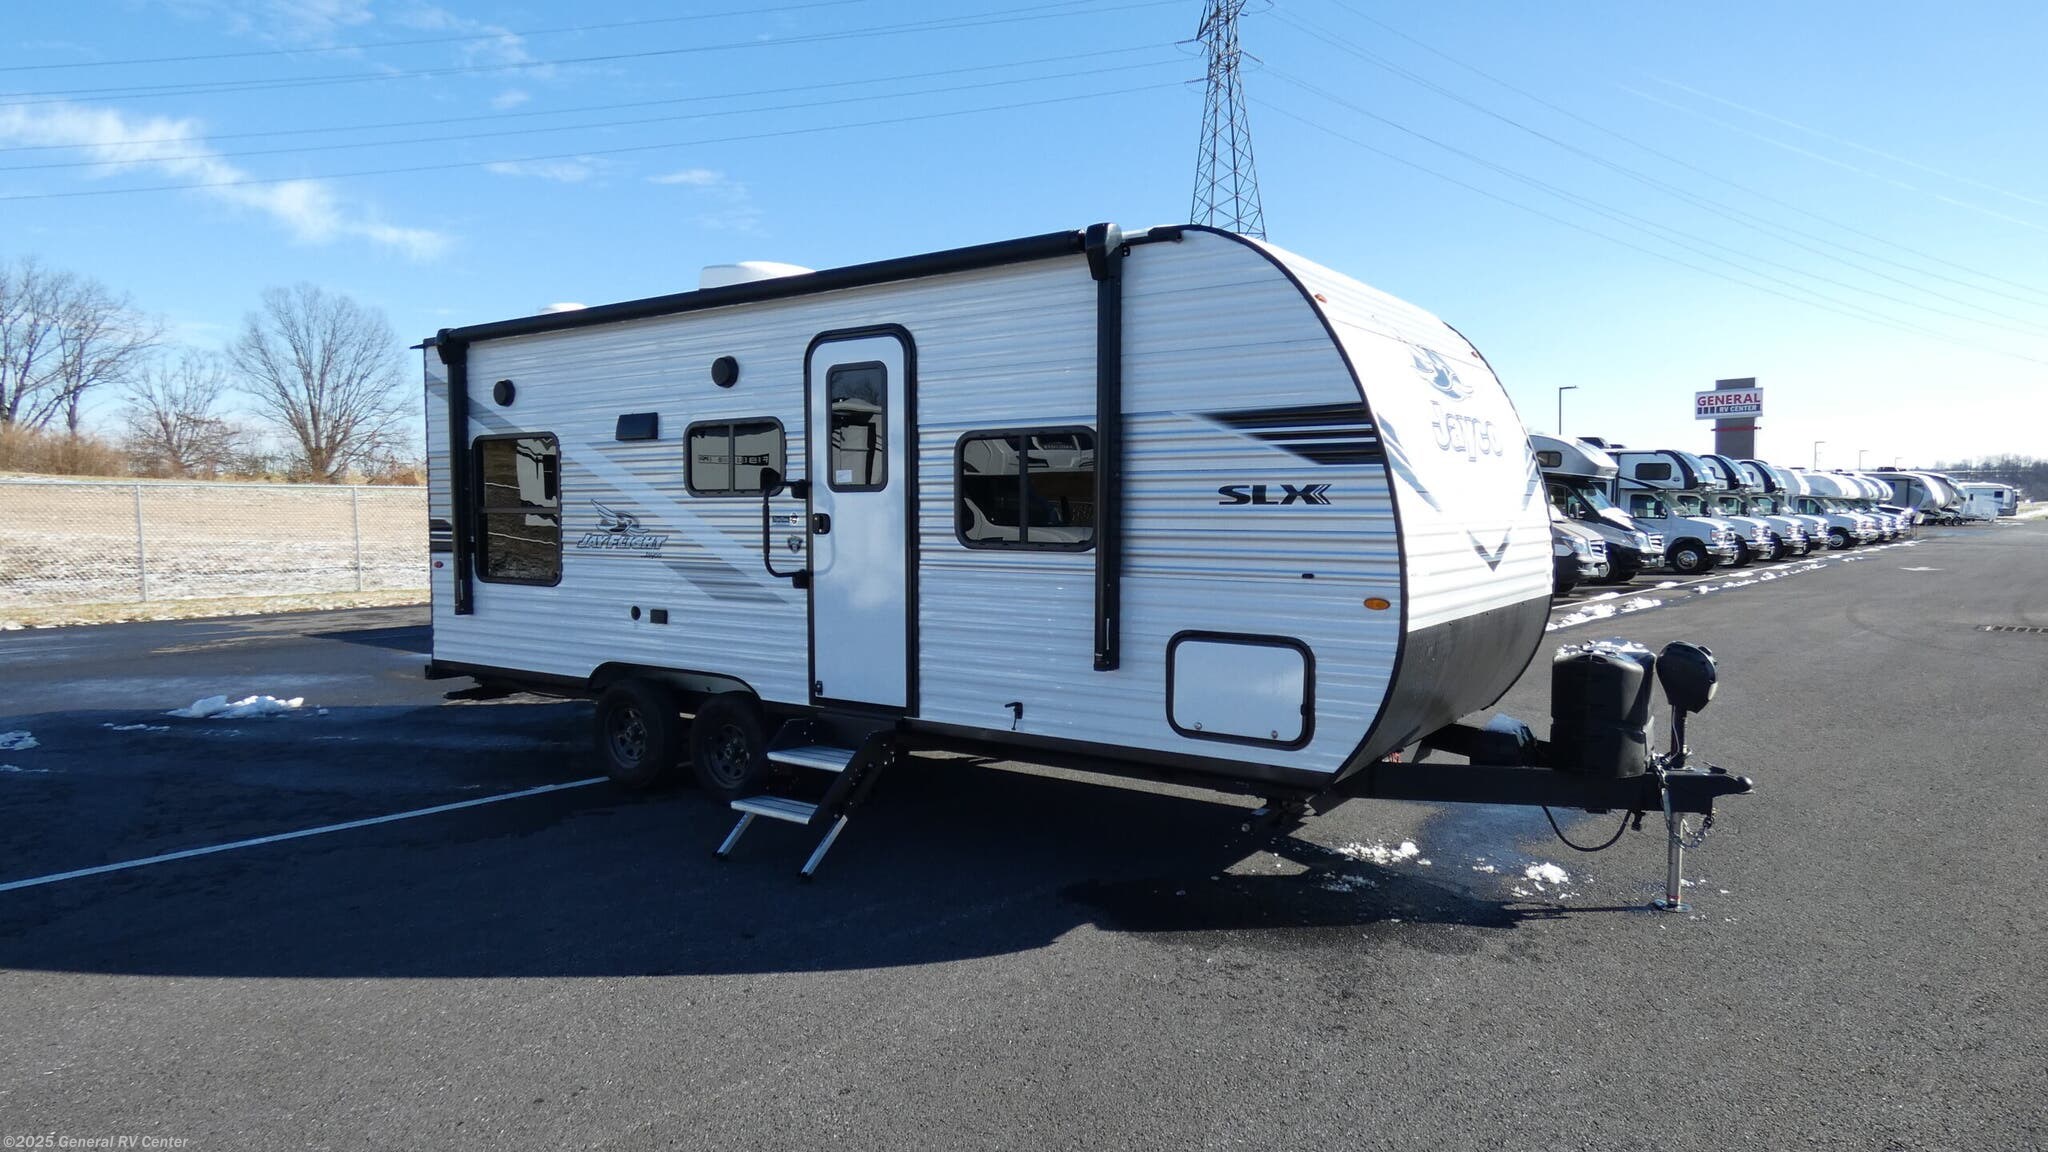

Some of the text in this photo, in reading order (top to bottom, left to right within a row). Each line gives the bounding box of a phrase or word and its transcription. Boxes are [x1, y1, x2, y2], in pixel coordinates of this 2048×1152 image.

[1697, 393, 1761, 406] GENERAL
[1429, 400, 1504, 463] Jayco
[1217, 484, 1333, 506] SLX
